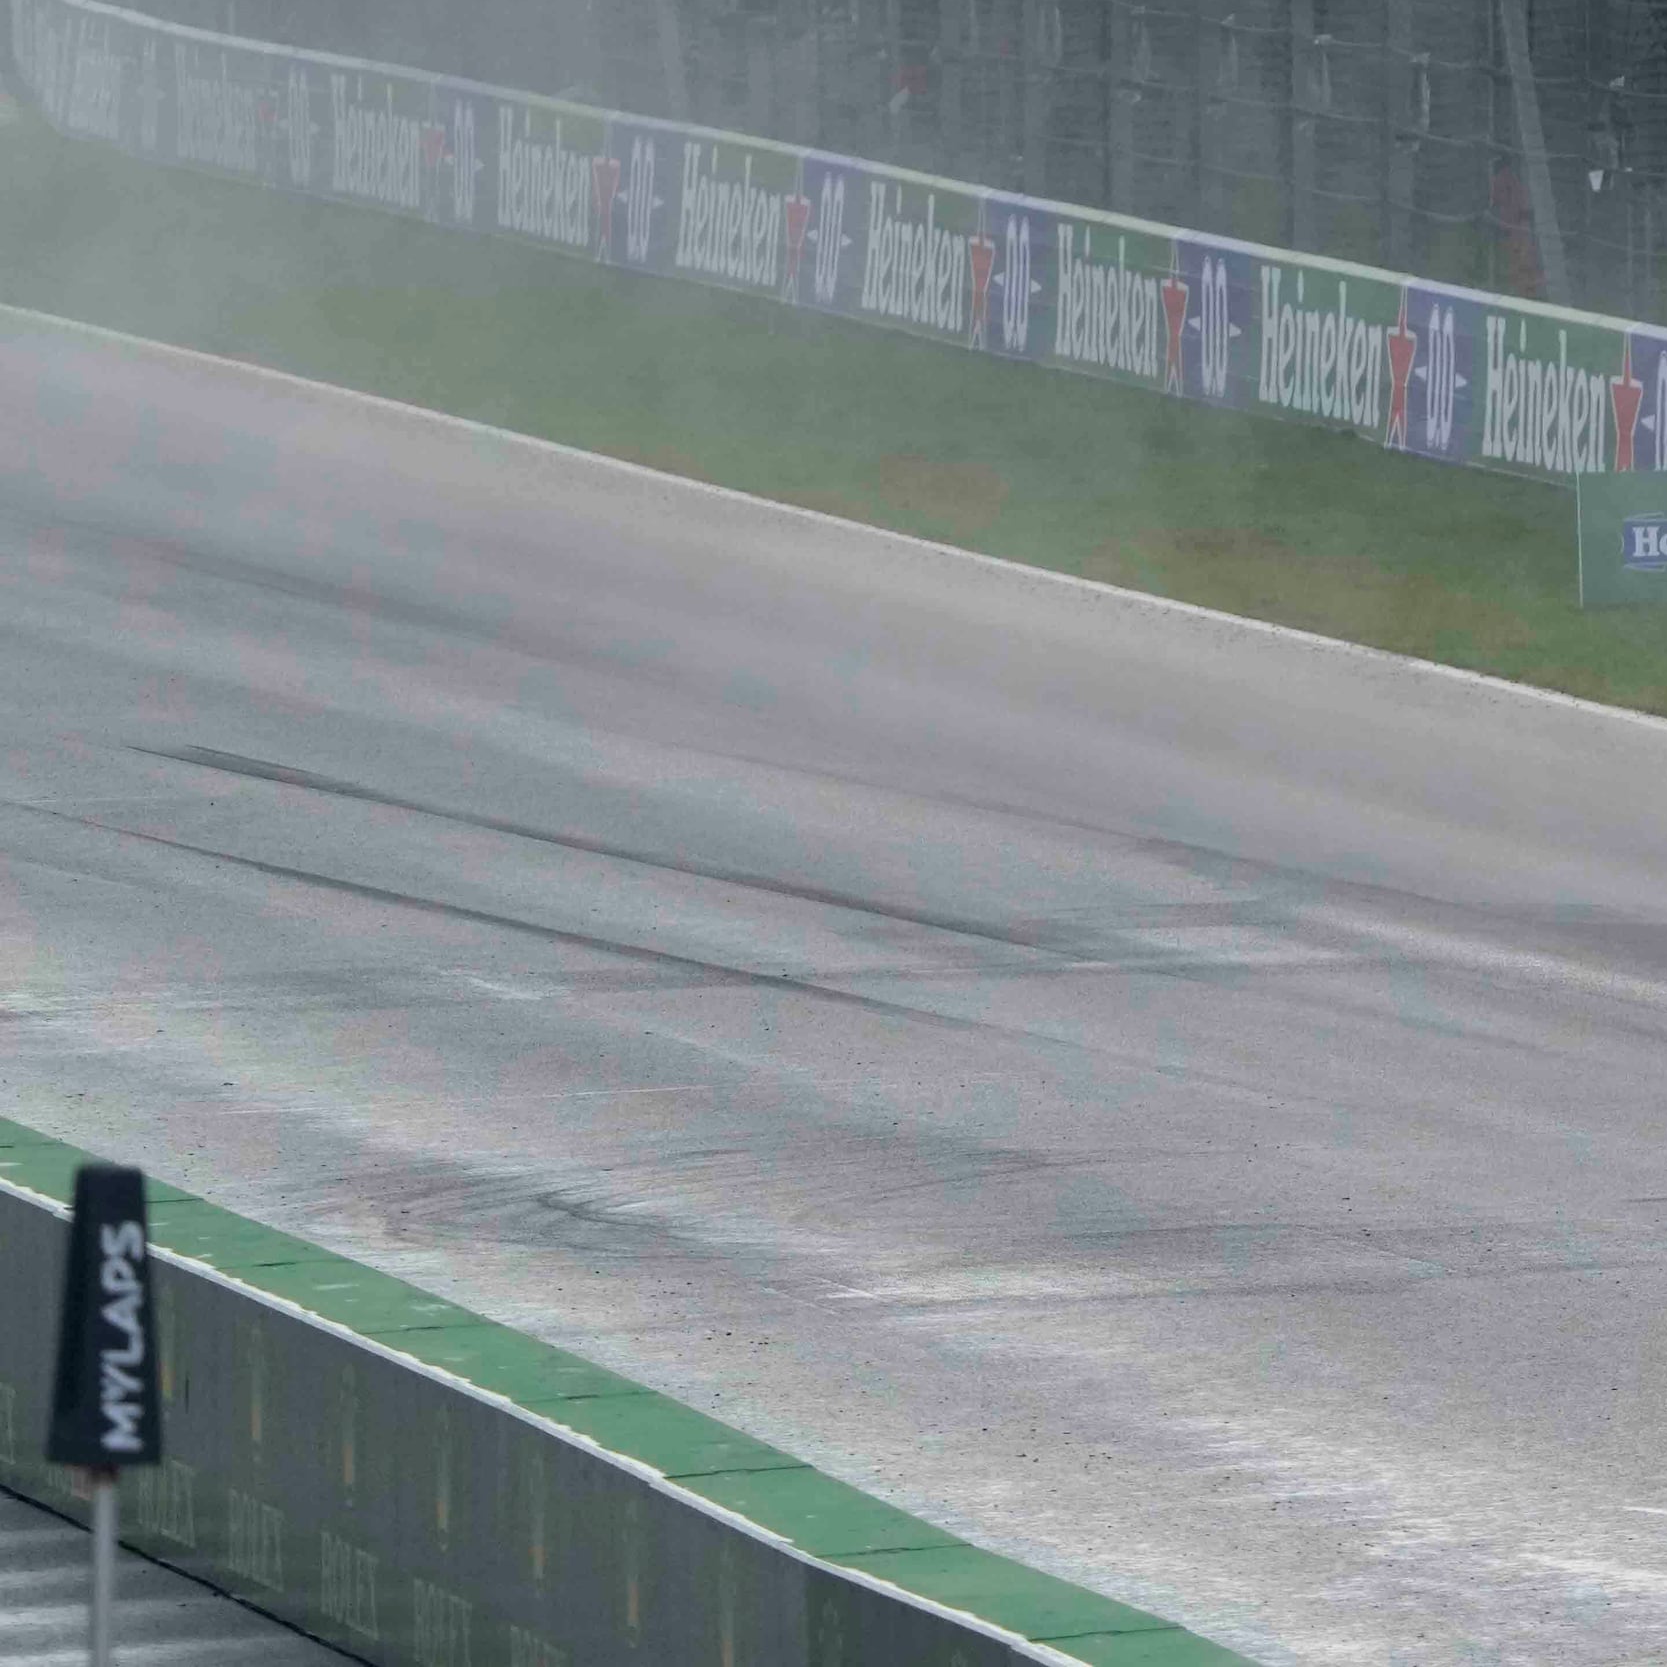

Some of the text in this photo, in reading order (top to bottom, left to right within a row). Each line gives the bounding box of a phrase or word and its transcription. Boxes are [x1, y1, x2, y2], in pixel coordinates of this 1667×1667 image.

[498, 106, 590, 247] Heineken
[675, 141, 782, 287] Heineken
[861, 180, 966, 332] Heineken
[1055, 223, 1159, 378] Heineken
[1258, 265, 1383, 429] Heineken
[1482, 315, 1606, 472] Heineken
[101, 1220, 146, 1453] MYLAPS
